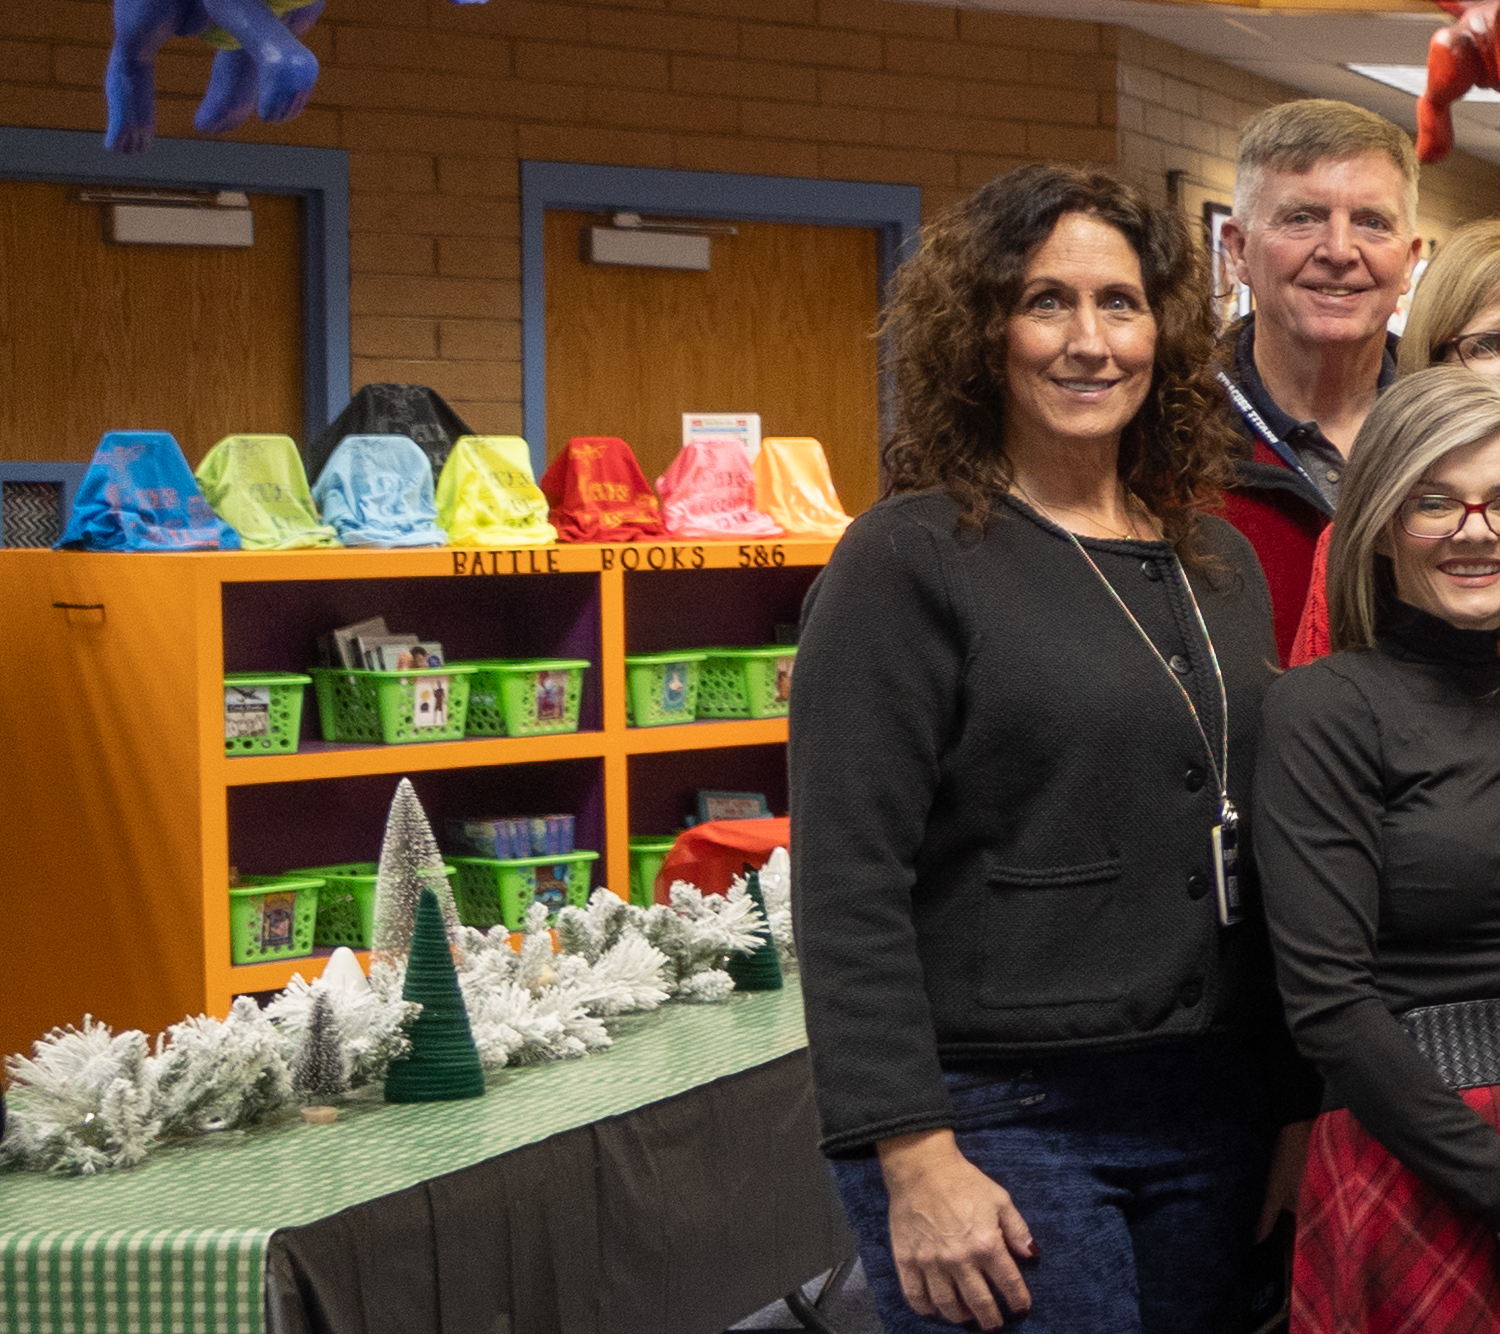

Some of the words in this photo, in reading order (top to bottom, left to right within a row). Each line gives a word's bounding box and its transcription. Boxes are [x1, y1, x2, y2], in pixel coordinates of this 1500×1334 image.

[1247, 410, 1279, 443] TITANS
[452, 548, 560, 575] BATTLE
[600, 546, 704, 571] BOOKS
[738, 544, 786, 568] 5&6
